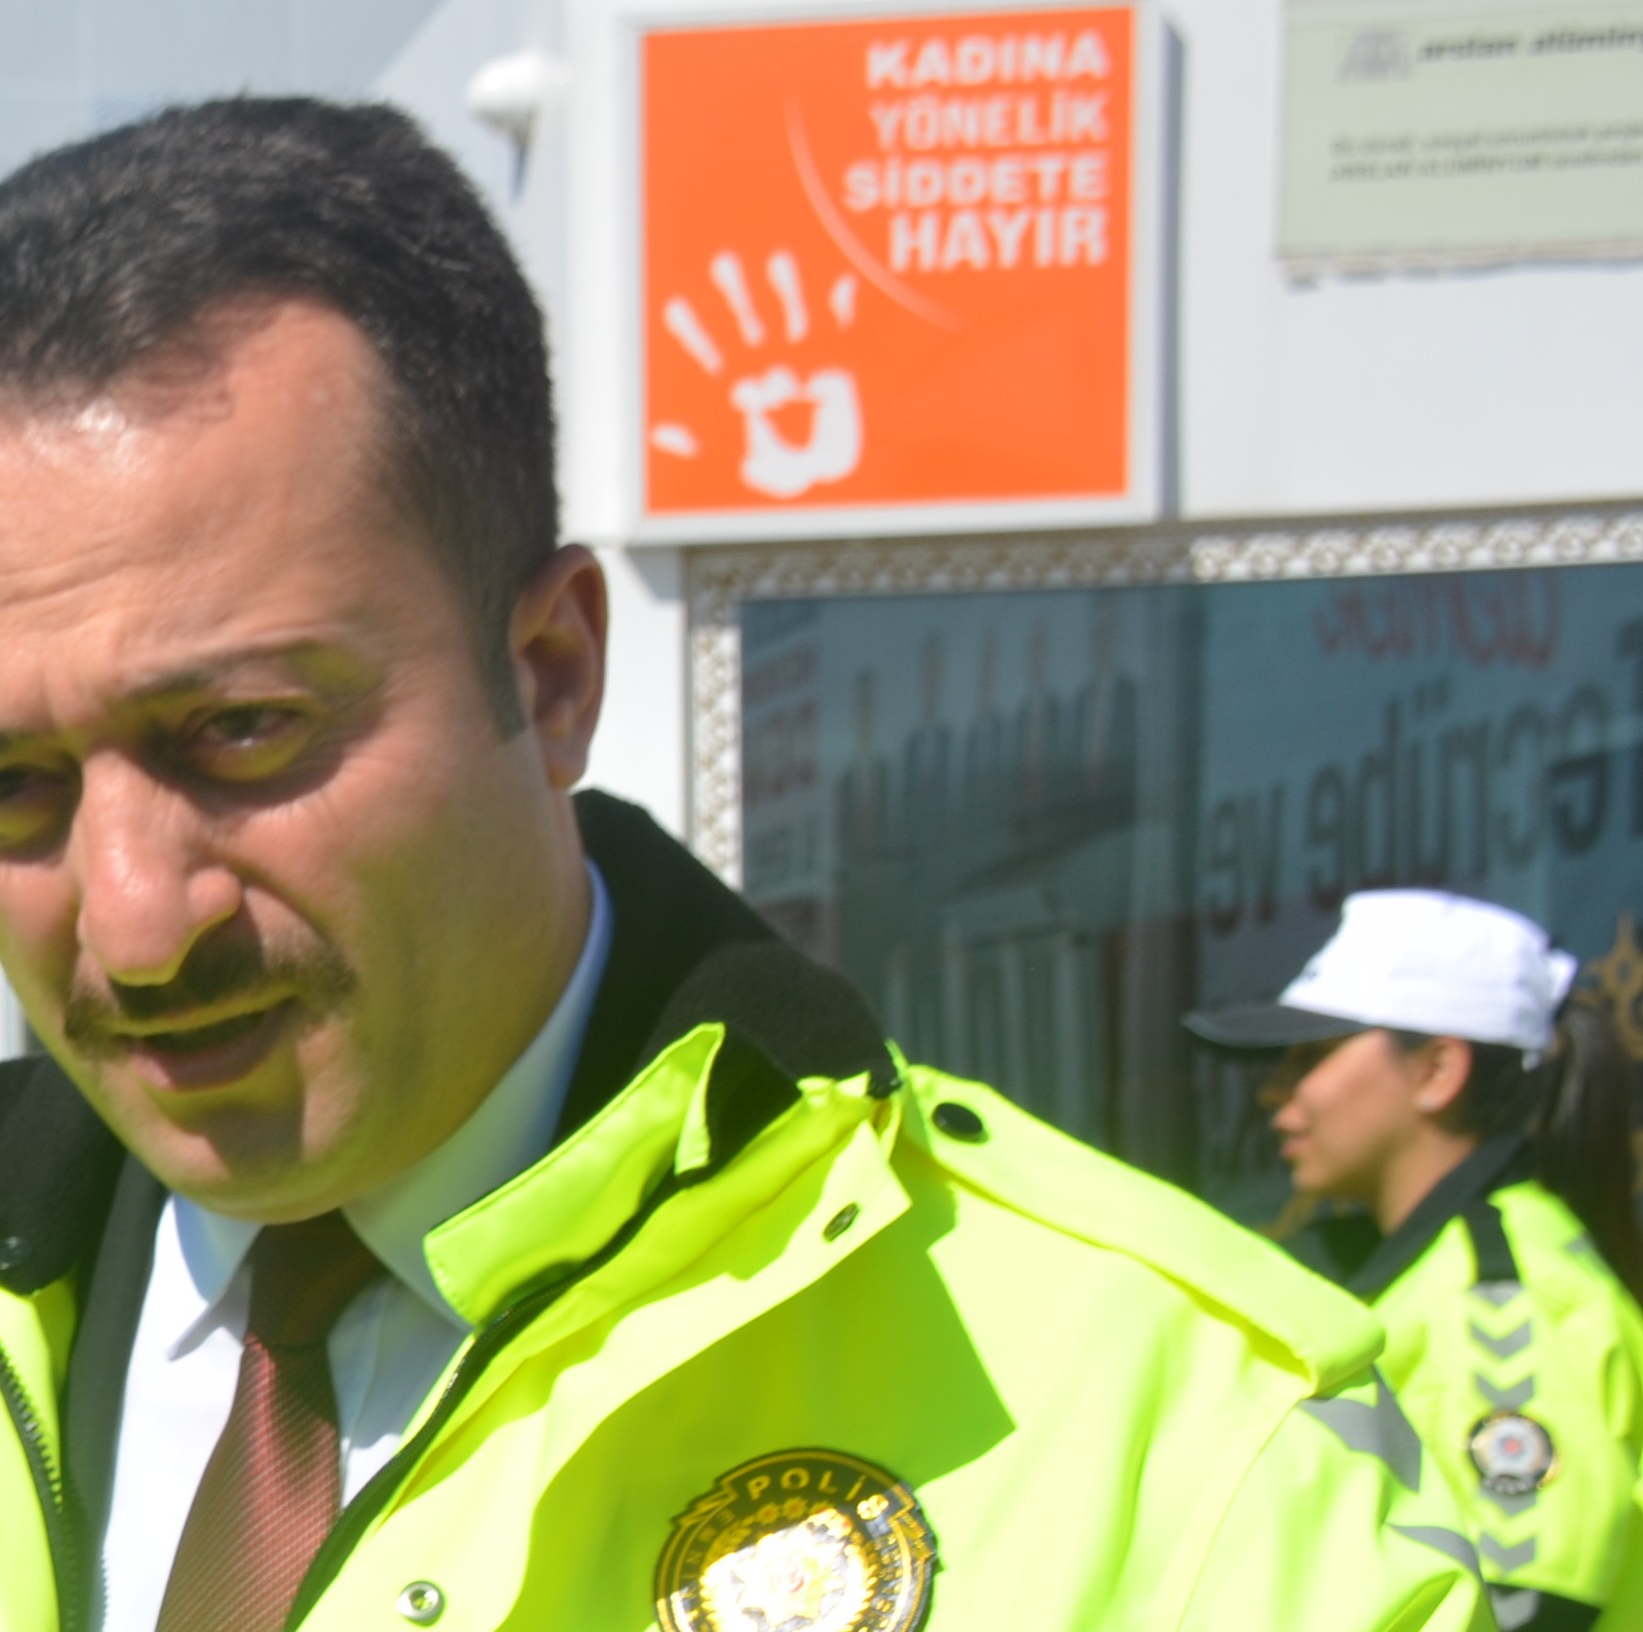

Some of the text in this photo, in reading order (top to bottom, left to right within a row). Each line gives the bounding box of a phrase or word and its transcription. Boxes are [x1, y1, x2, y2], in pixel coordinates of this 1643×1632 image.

[867, 31, 1107, 87] KADINA
[871, 93, 1107, 148] YÖNELİK
[845, 154, 1107, 211] ŞİDDETE
[891, 209, 1107, 272] HAYIR
